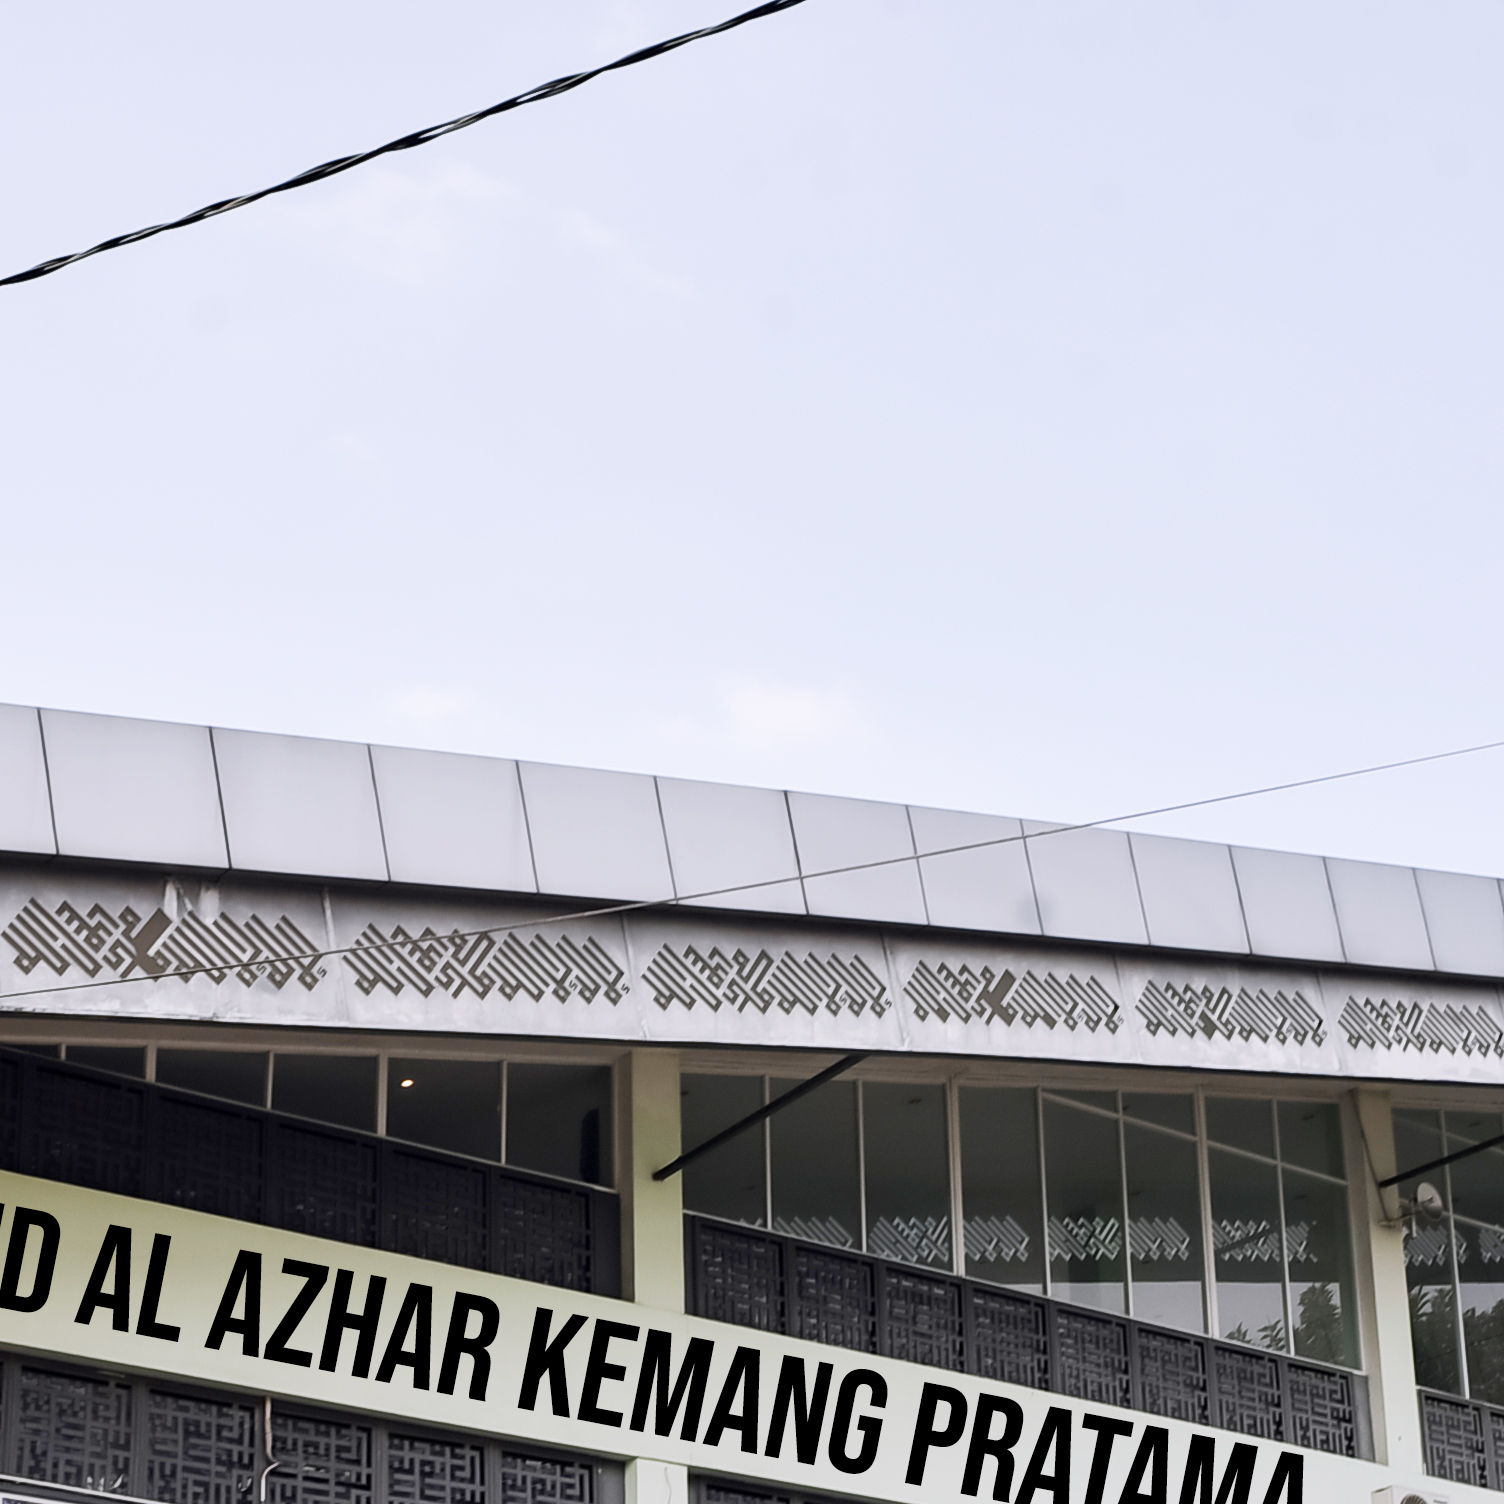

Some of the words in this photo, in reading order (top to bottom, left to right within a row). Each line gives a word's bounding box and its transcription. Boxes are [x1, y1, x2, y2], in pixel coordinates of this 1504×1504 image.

[74, 1224, 181, 1343] AL
[204, 1249, 500, 1402] AZHAR
[517, 1306, 888, 1475] KEMANG
